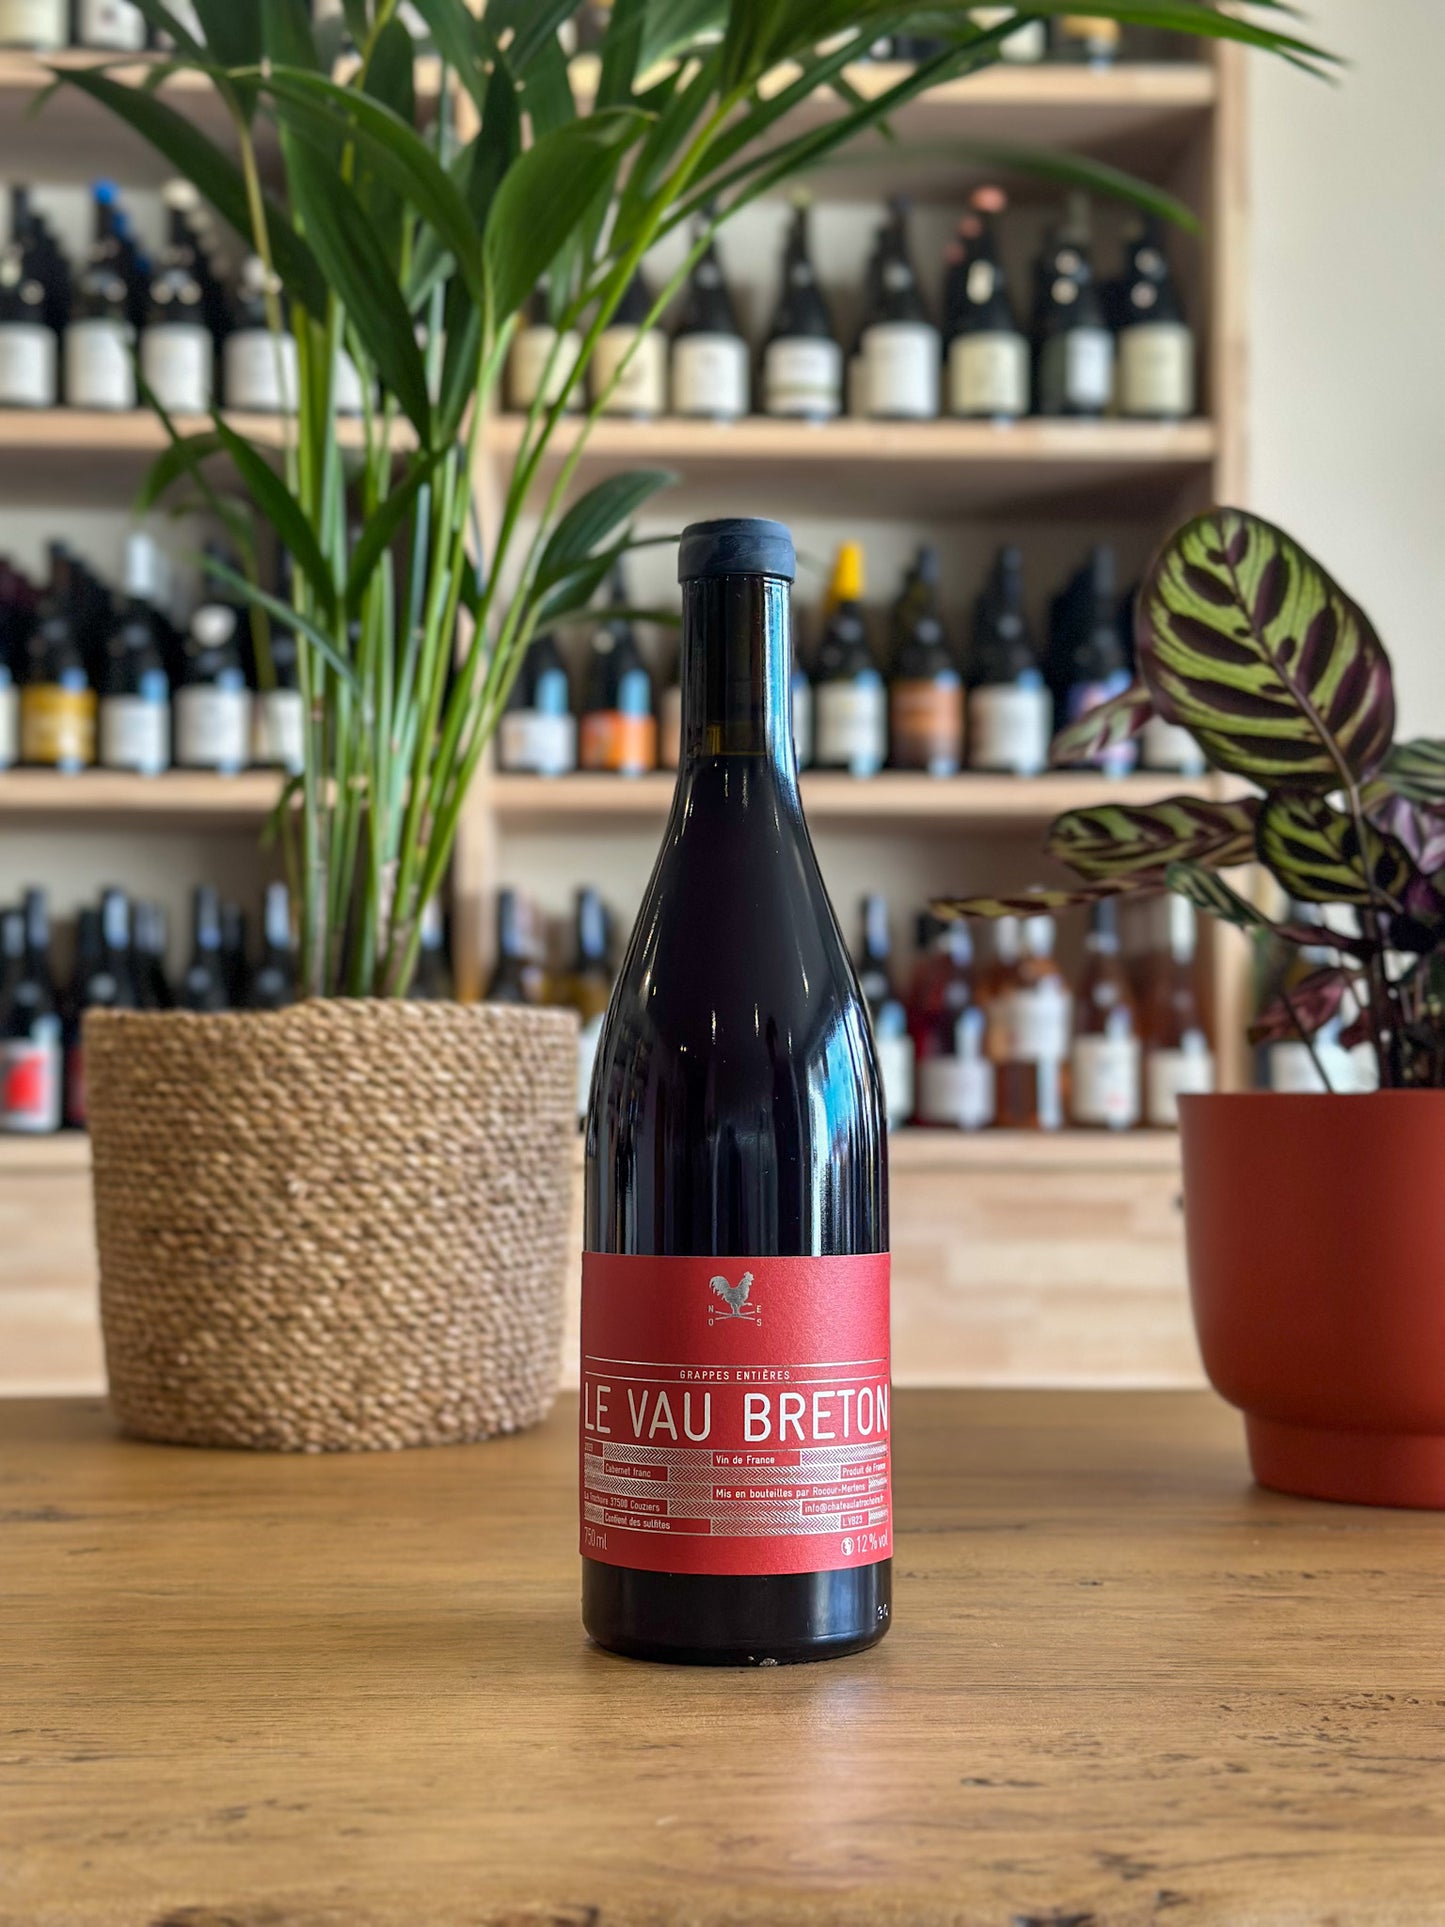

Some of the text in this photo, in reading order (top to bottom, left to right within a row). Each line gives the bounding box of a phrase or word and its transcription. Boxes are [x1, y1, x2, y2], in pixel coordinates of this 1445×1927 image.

[708, 1305, 762, 1313] N E
[756, 1318, 762, 1327] S
[680, 1368, 791, 1380] GRAPPES ENTIÈRES
[584, 1382, 888, 1442] LE VAU BRETON
[716, 1455, 775, 1464] Vin de France
[605, 1463, 651, 1477] Cabernet franc
[842, 1466, 865, 1477] Produit
[865, 1464, 872, 1473] de
[716, 1483, 866, 1500] Mis en bouteilles par Rocour-Mertens
[630, 1500, 660, 1512] Couziers
[605, 1512, 671, 1530] Contient des sulfites
[878, 1529, 888, 1548] vol
